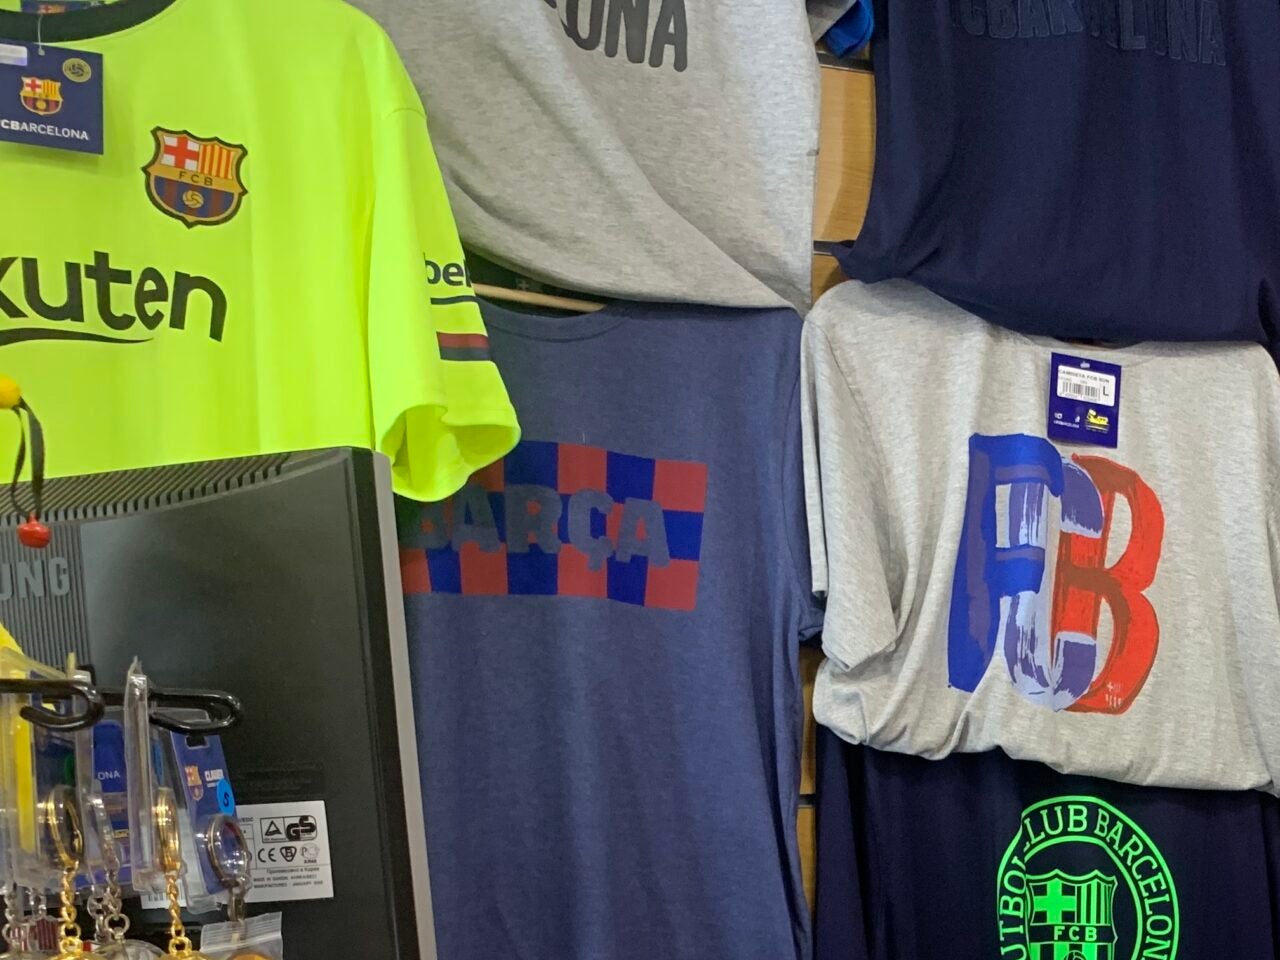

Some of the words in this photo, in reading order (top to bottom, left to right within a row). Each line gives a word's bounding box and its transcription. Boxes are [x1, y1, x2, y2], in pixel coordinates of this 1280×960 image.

[0, 118, 89, 141] CBARCELONA
[178, 170, 214, 187] FCB
[1023, 804, 1088, 848] LUB
[1053, 925, 1098, 942] FCB
